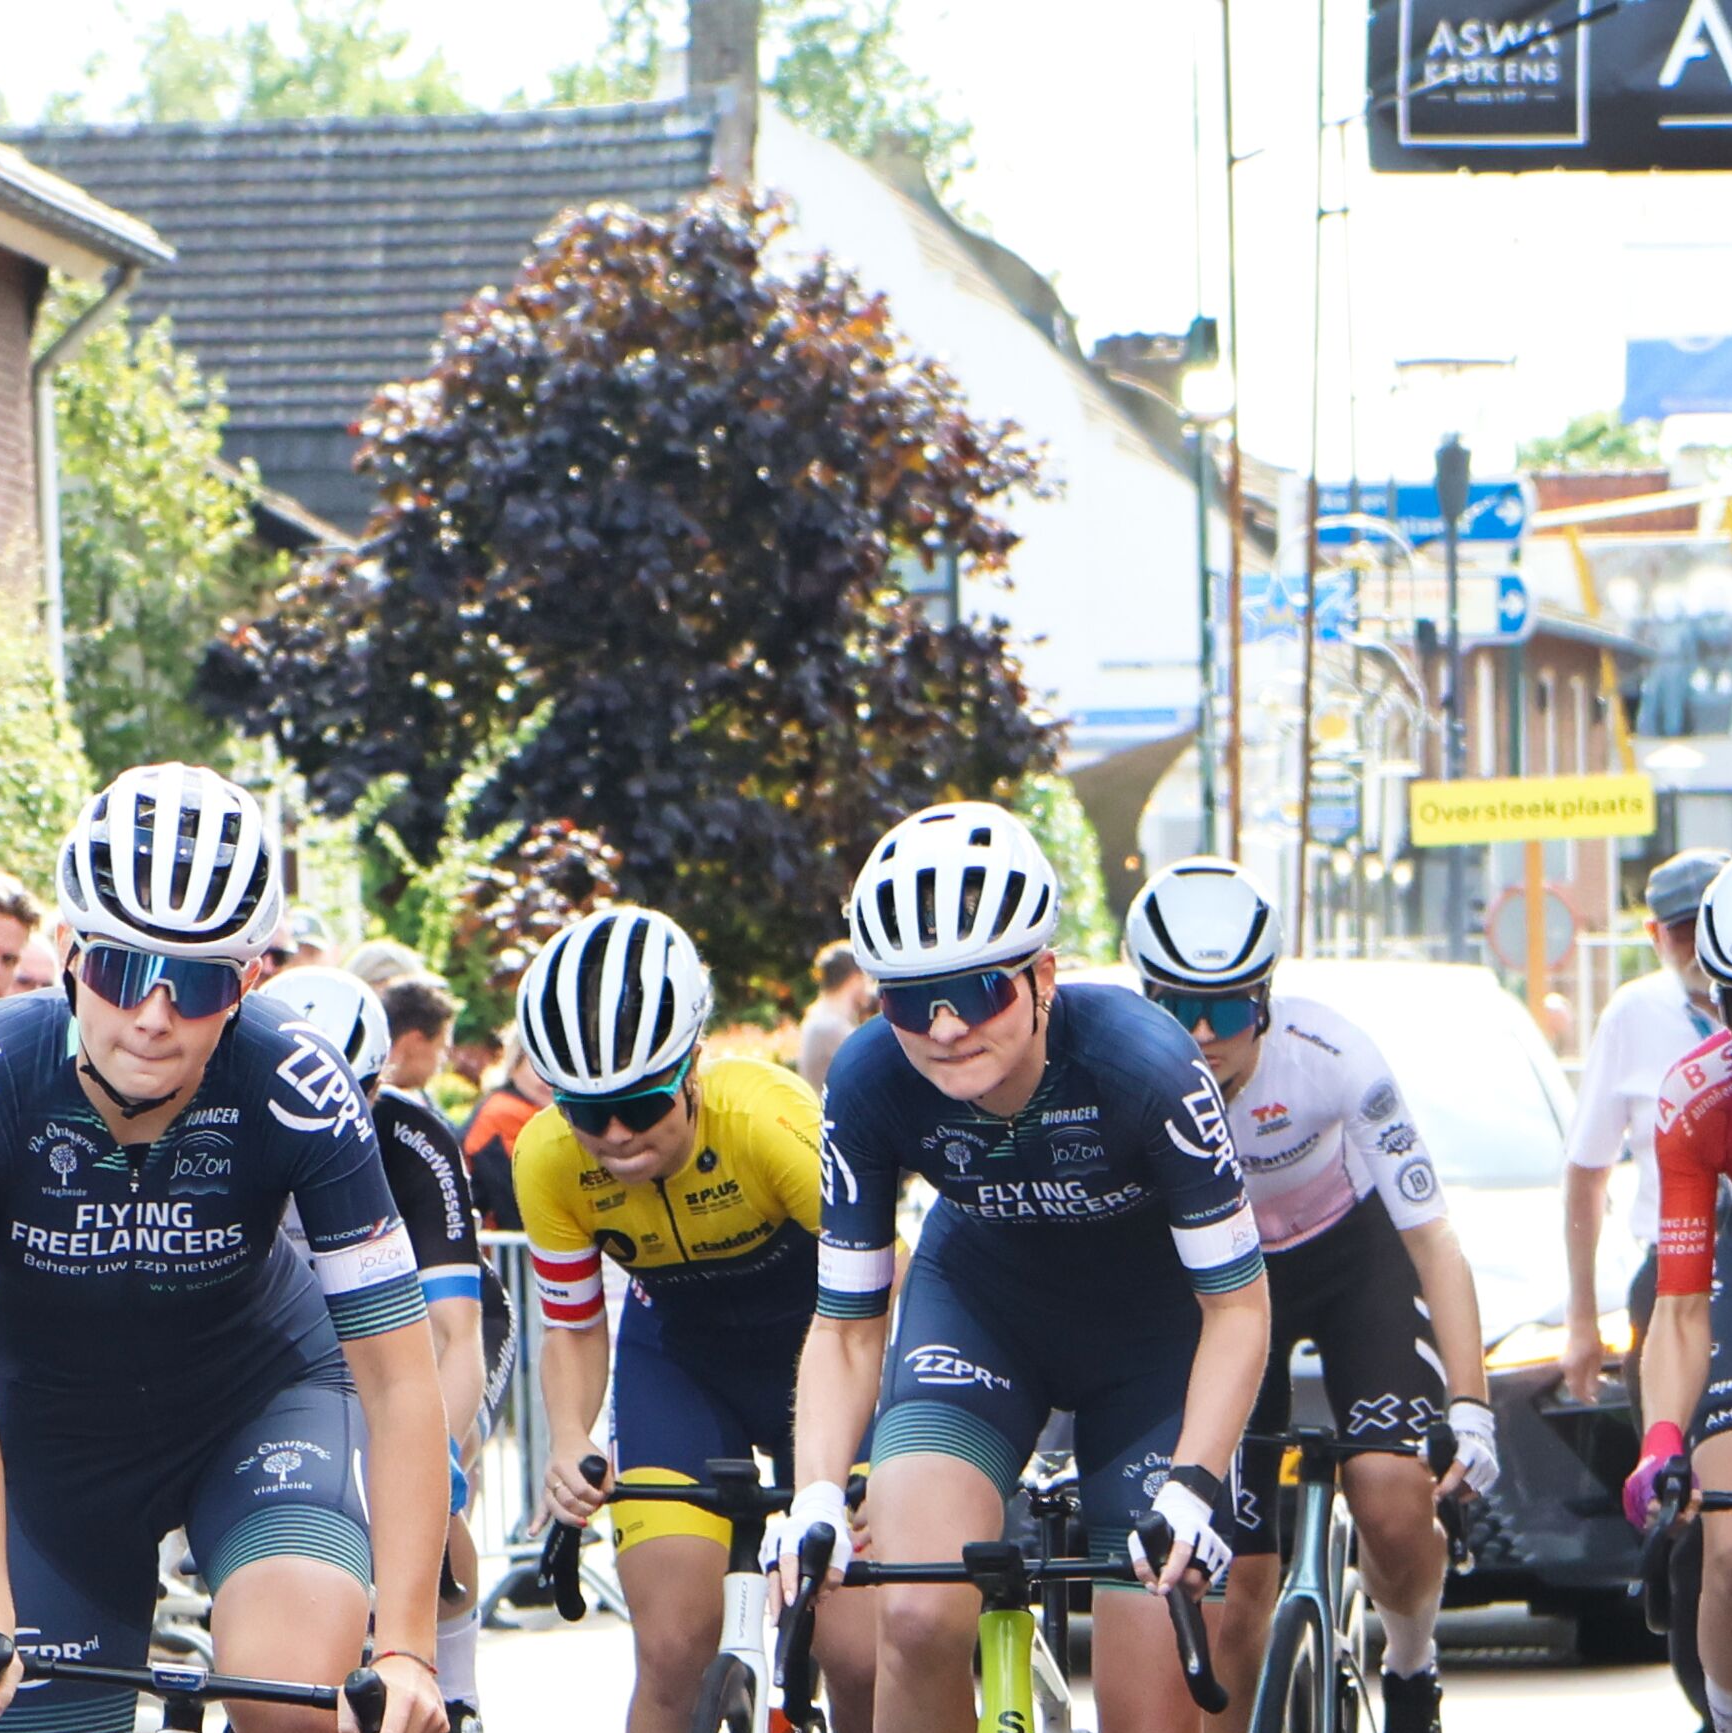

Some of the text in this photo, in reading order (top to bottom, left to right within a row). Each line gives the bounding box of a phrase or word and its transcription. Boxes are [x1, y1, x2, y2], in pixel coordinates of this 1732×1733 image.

[1426, 18, 1560, 58] ASWA
[1423, 60, 1559, 84] KEUKENS
[1419, 796, 1646, 826] Oversteekplaats
[275, 1033, 373, 1144] ZZPR.nl
[1040, 1106, 1100, 1126] BIORACER
[169, 1150, 233, 1181] joZon
[393, 1120, 467, 1242] VolkerWessels
[977, 1181, 1088, 1204] FLYING
[75, 1202, 194, 1231] FLYING
[10, 1220, 244, 1257] FREELANCERS
[23, 1243, 252, 1277] Beheer uw zzp network!
[913, 1354, 1012, 1392] ZZPR.nl
